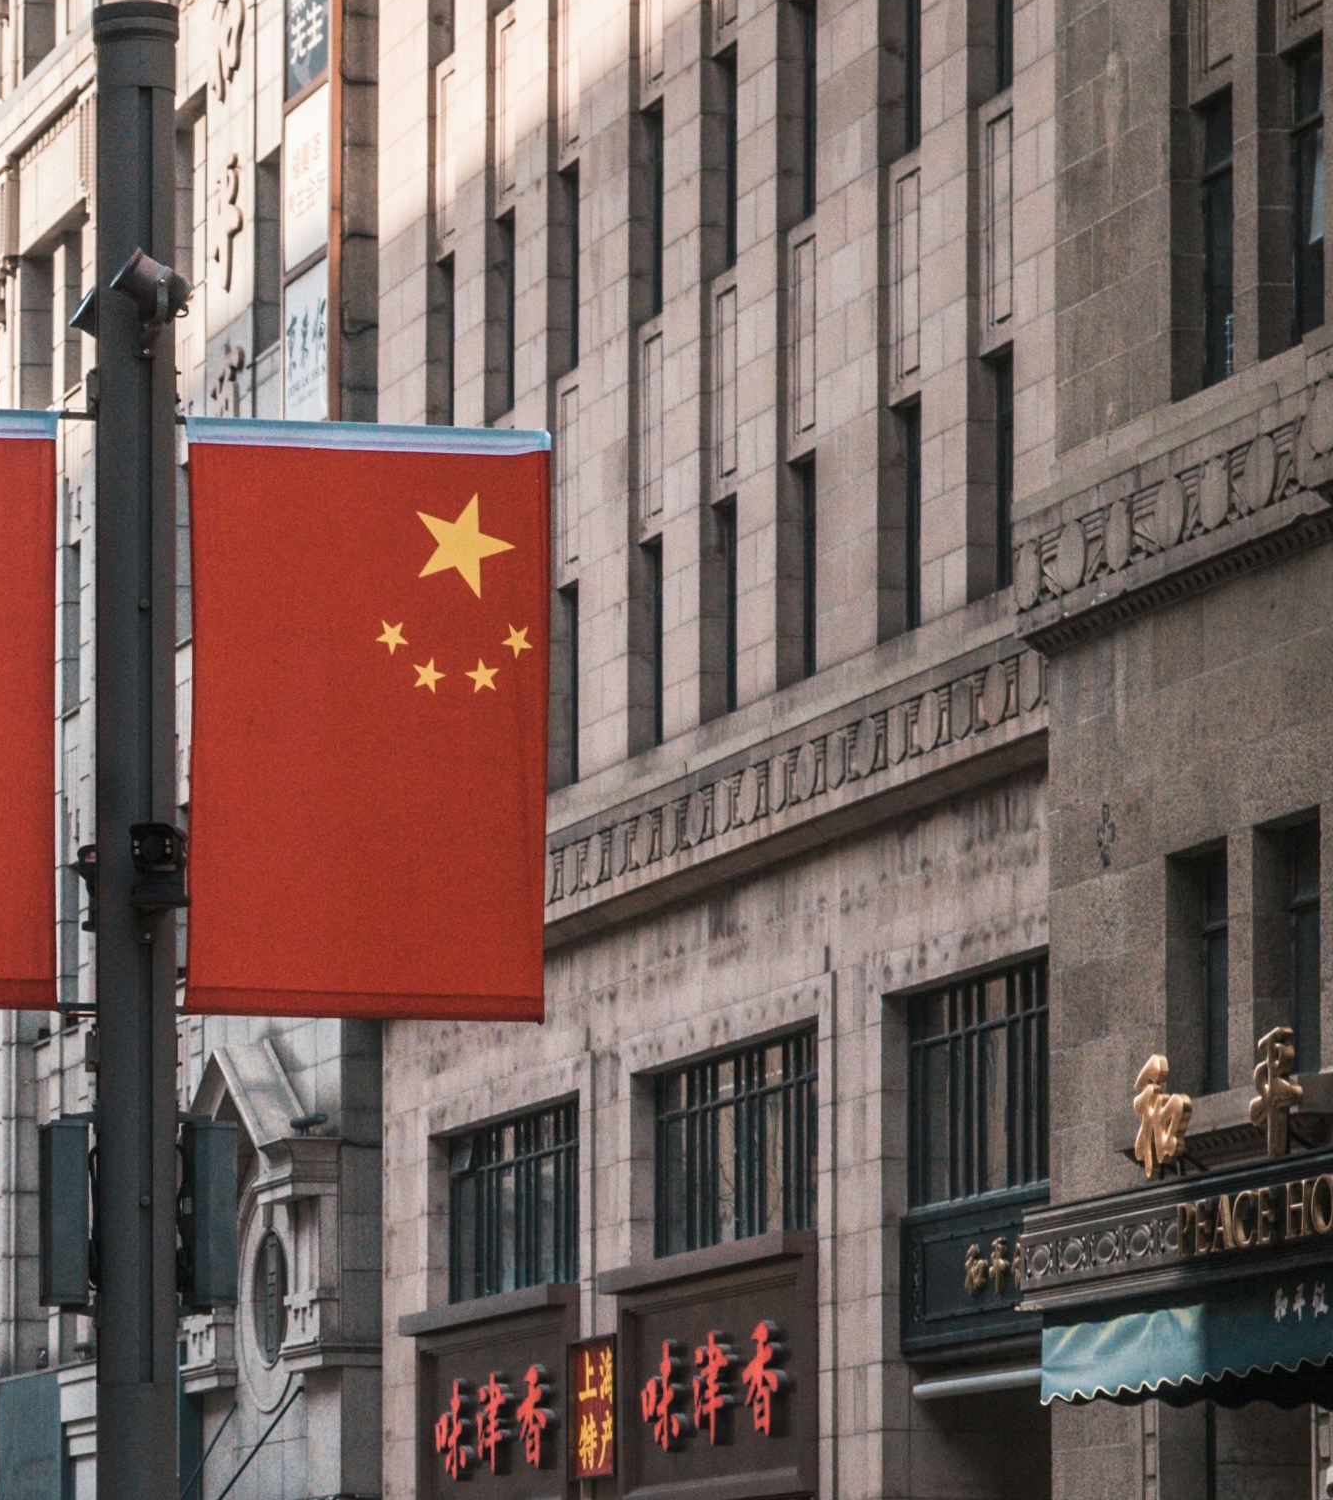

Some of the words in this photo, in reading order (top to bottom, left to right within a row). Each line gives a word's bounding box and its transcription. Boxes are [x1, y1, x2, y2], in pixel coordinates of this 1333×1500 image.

[290, 1, 324, 65] 先生
[1133, 1026, 1304, 1178] 和平
[1177, 1186, 1276, 1258] PEACE
[578, 1345, 613, 1405] 上海
[641, 1319, 779, 1453] 味津香
[435, 1363, 547, 1481] 味津香
[578, 1408, 613, 1471] 特产
